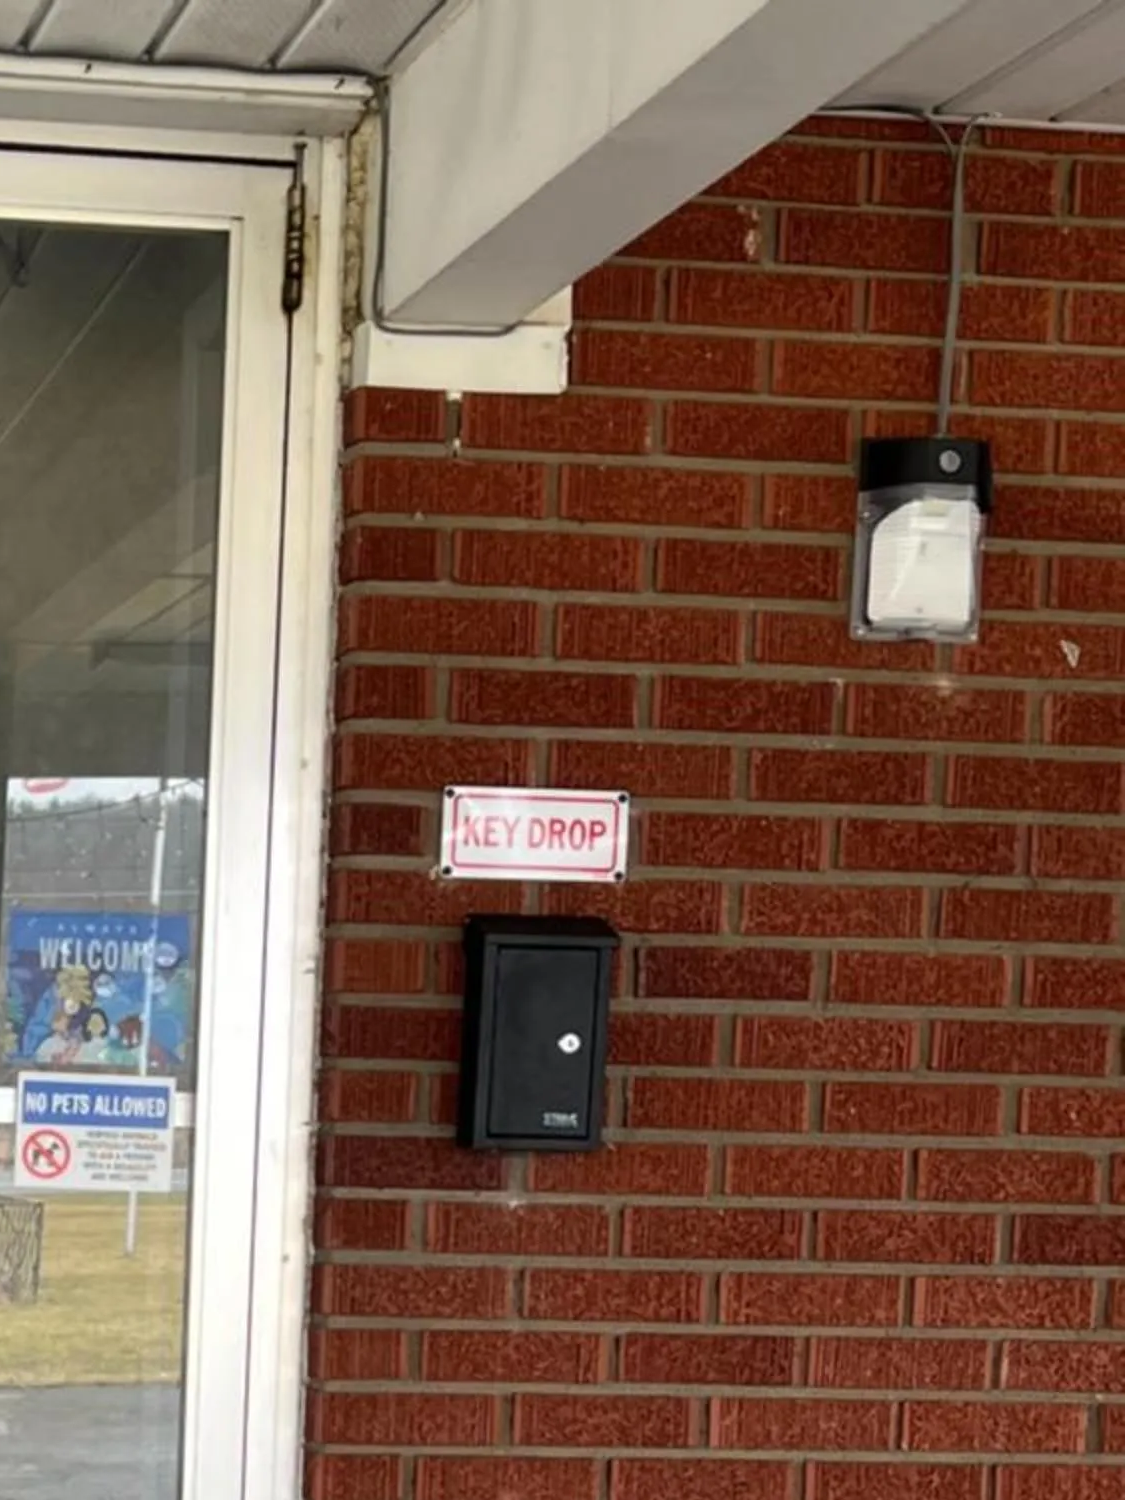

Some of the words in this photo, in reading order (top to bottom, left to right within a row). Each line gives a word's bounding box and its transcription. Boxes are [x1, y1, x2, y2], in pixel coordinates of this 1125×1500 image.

[462, 814, 521, 848] KEY
[527, 816, 607, 851] DROP
[25, 1091, 47, 1114] NO
[51, 1092, 90, 1116] PETS
[93, 1094, 166, 1119] ALLOWED
